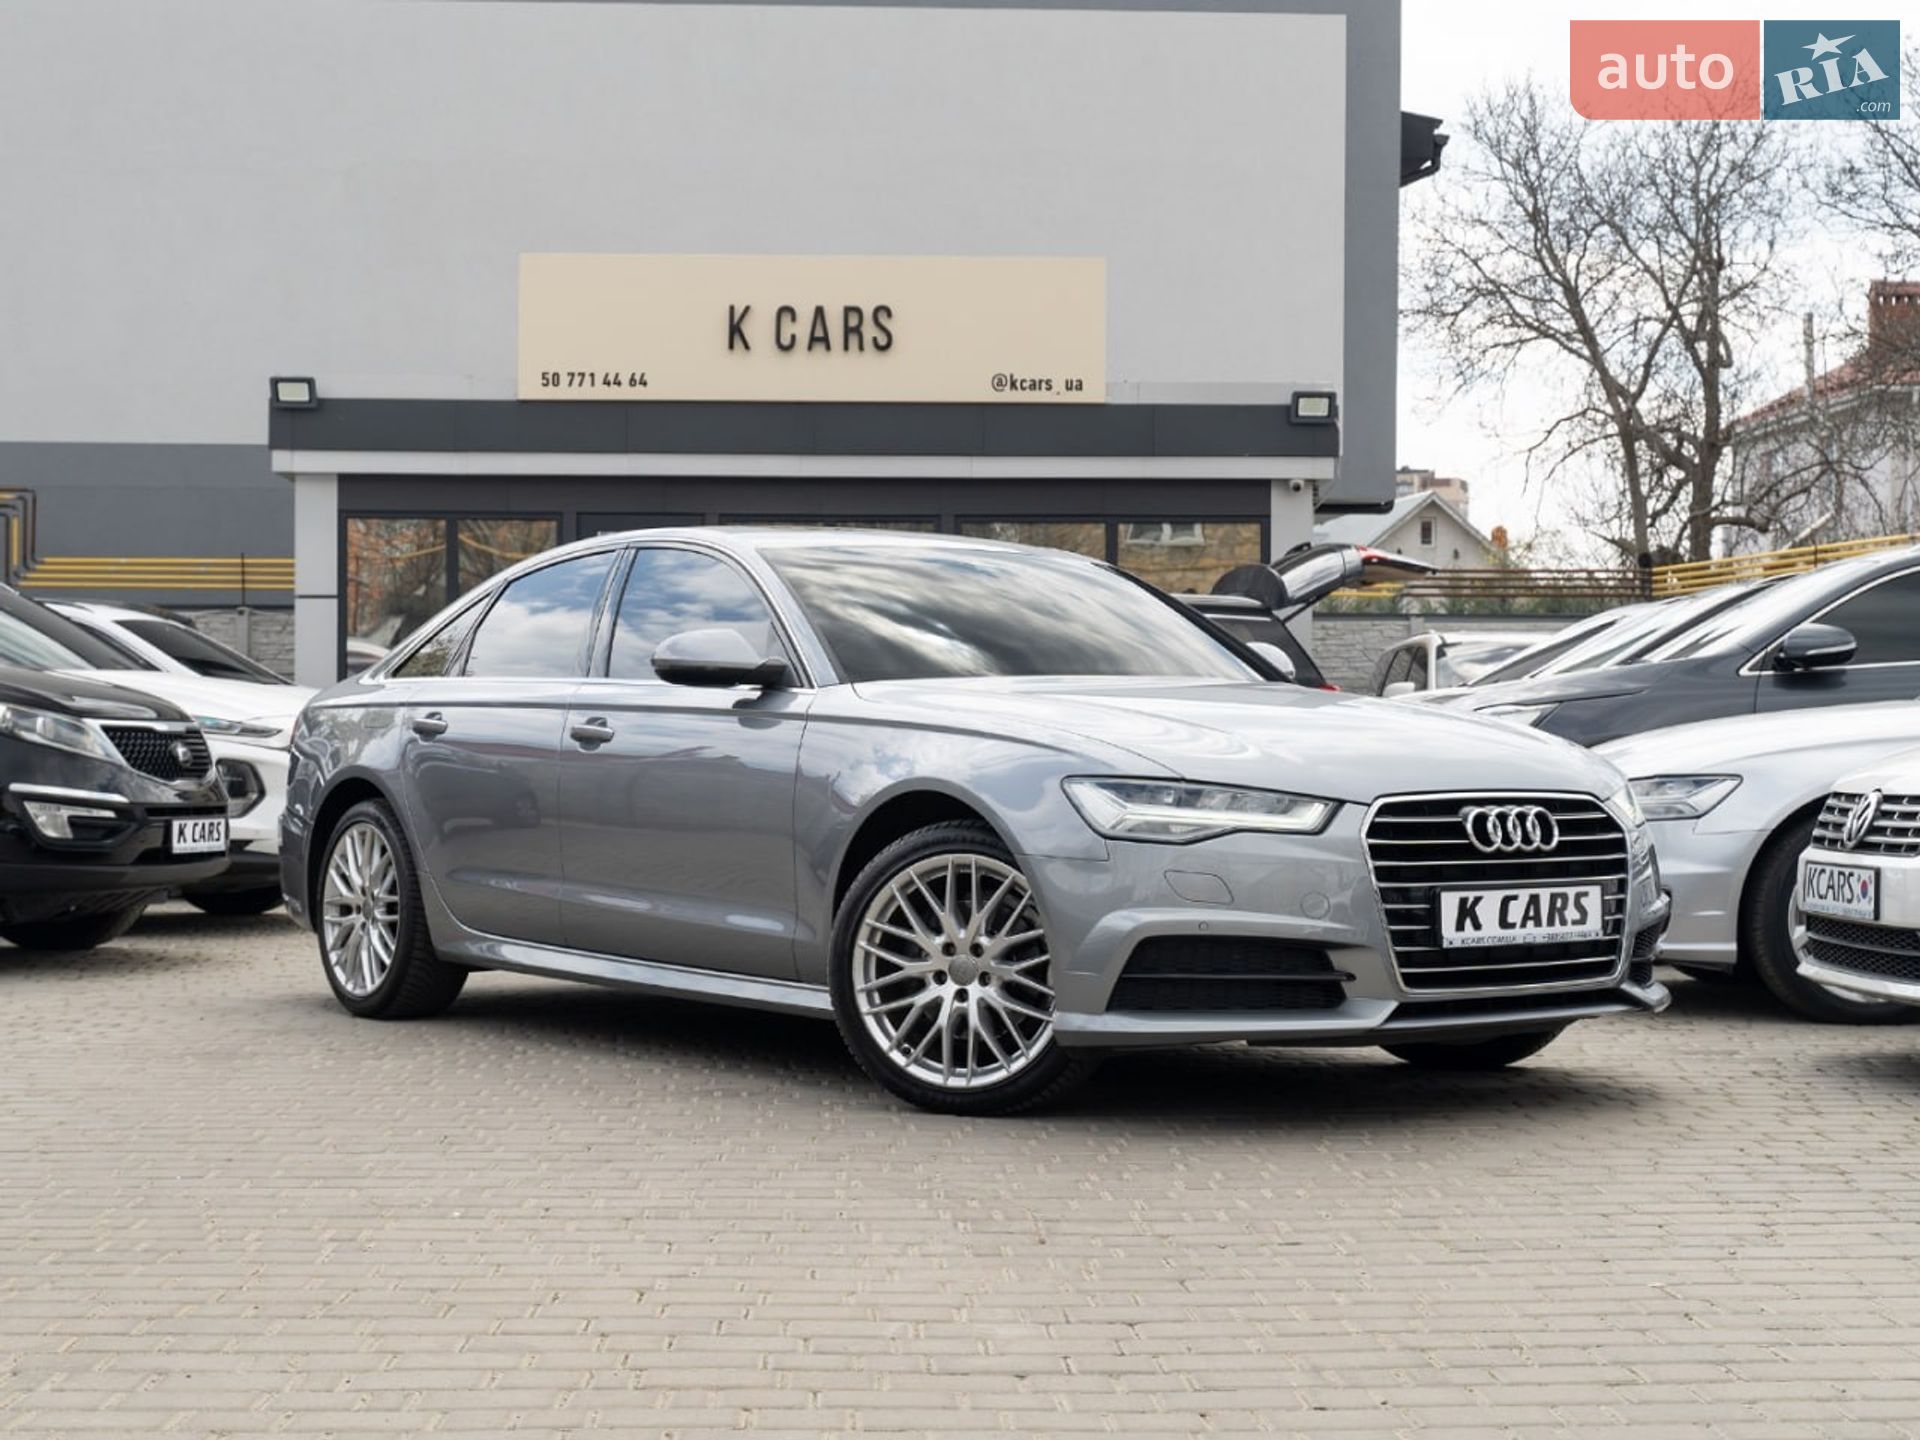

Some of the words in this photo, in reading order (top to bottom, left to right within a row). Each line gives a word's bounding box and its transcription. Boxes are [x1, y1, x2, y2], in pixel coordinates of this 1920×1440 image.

[727, 304, 752, 351] K
[775, 304, 893, 352] CARS
[541, 371, 561, 388] 50
[566, 371, 596, 388] 771
[602, 371, 622, 388] 44
[628, 371, 648, 388] 64
[177, 822, 188, 844] K
[192, 821, 222, 843] CARS
[1807, 866, 1855, 904] KCARS
[1455, 895, 1485, 933] K
[1498, 891, 1590, 930] CARS
